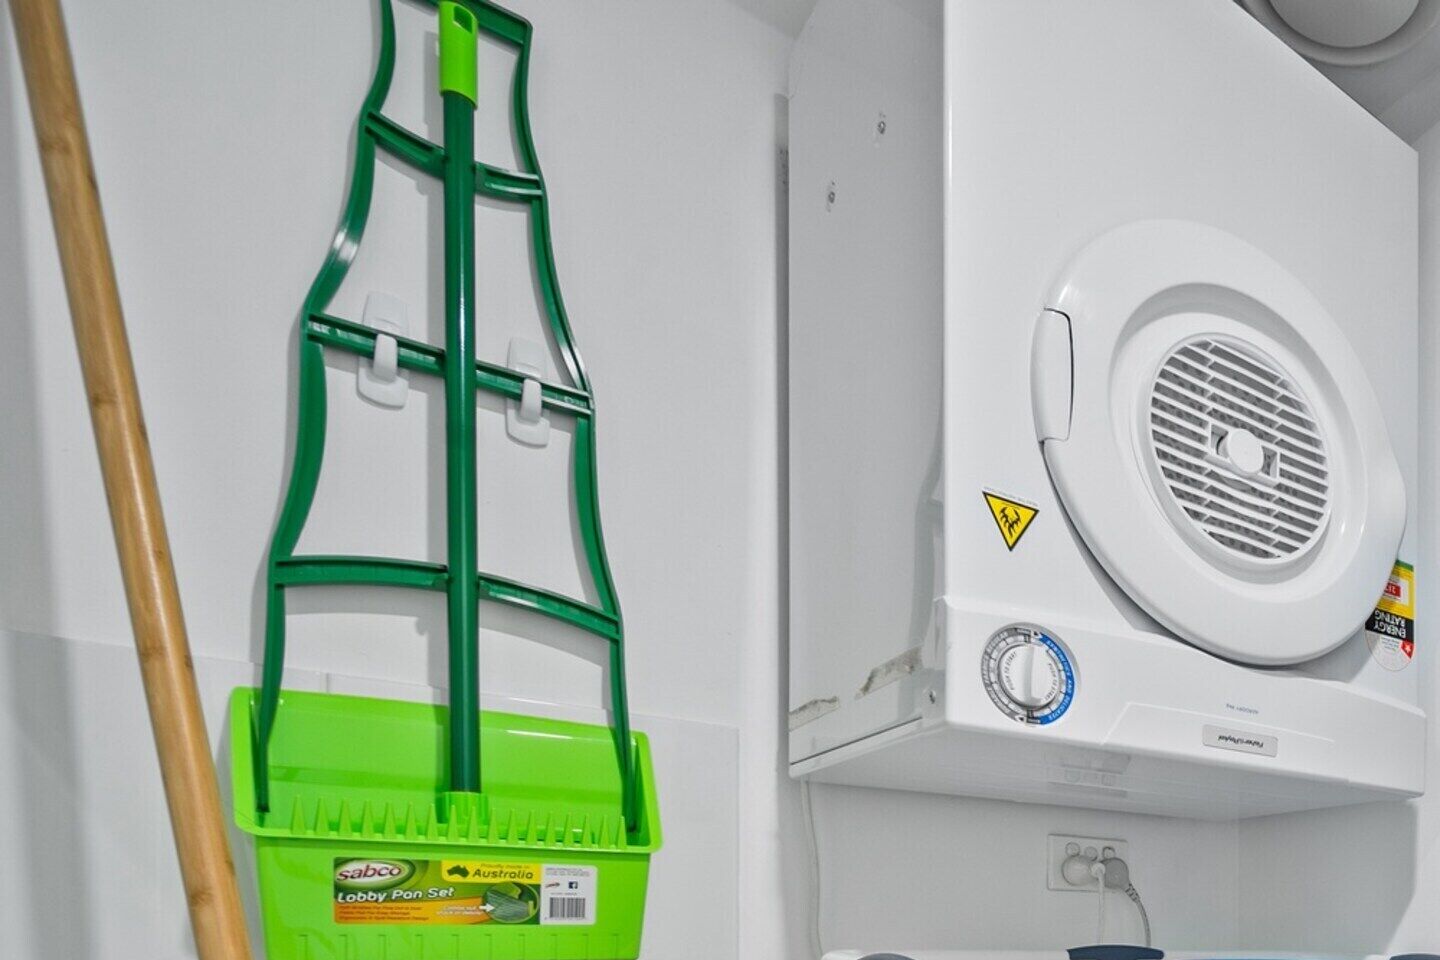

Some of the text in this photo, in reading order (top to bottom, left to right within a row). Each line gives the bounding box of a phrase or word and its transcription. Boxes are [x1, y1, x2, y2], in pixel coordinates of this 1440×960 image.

[1374, 610, 1406, 627] RATING
[1373, 620, 1406, 638] ENERGY
[336, 864, 401, 881] sabco
[472, 868, 534, 879] Australia
[338, 886, 455, 903] Lobby Pan Set
